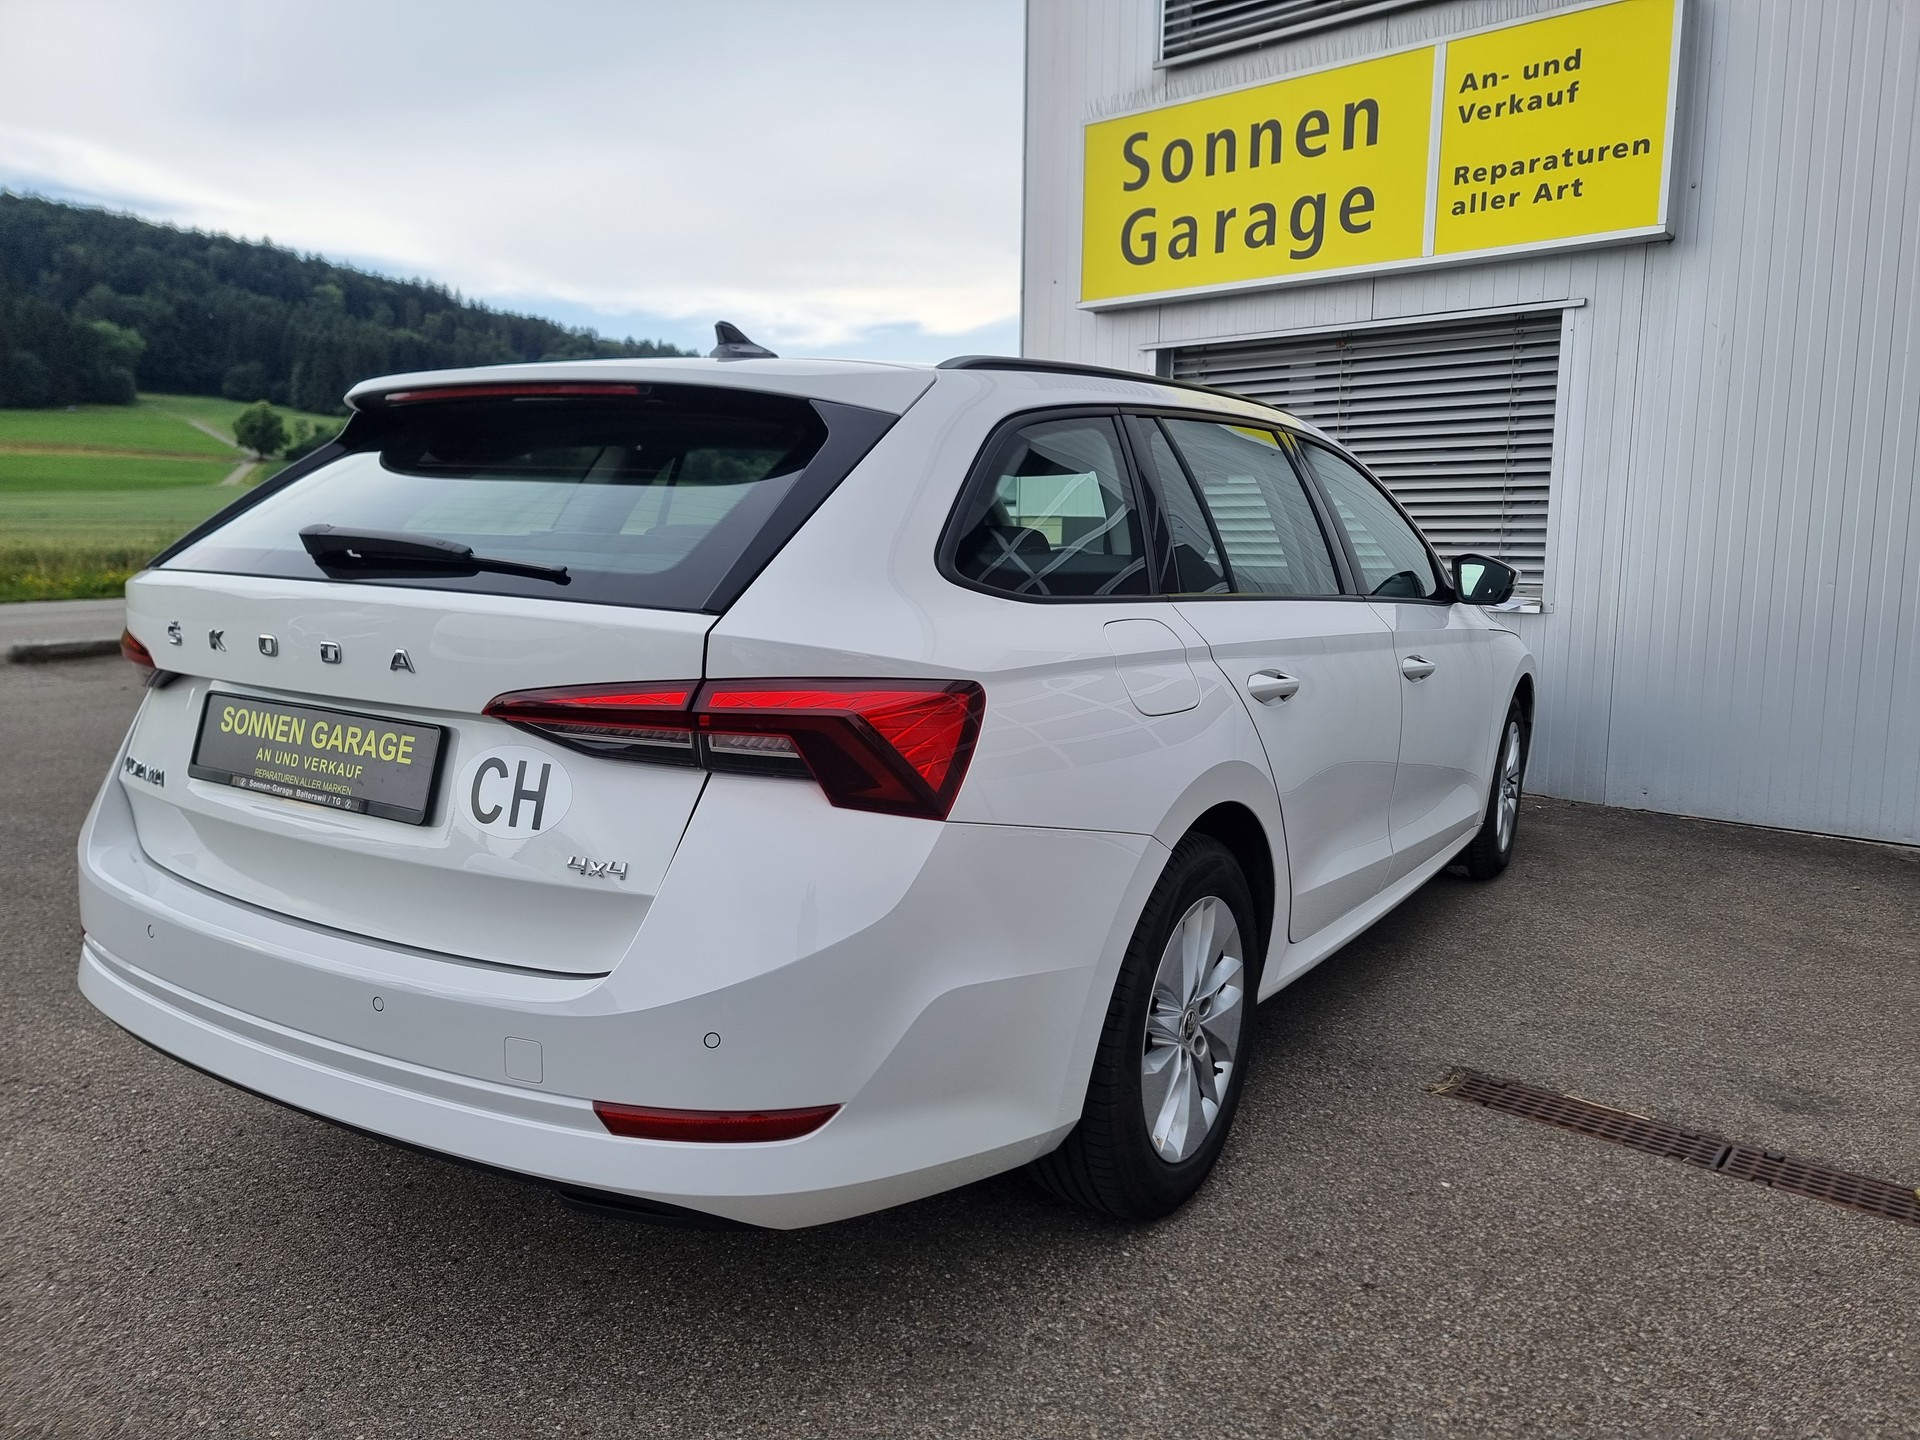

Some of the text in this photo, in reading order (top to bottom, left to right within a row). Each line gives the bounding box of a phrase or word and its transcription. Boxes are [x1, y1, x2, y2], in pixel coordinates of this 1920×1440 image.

[1458, 48, 1582, 94] An- und
[1458, 81, 1581, 125] Verkauf
[1122, 97, 1380, 192] Sonnen
[1453, 137, 1652, 186] Reparaturen
[1451, 178, 1584, 217] aller Art
[1120, 182, 1376, 266] Garage
[220, 706, 416, 765] SONNEN GARAGE
[255, 768, 352, 795] REPARATUREN ALLER MARKEN
[256, 747, 363, 780] AN UND VERKAUF
[249, 779, 293, 795] Sonnen-Garage
[332, 796, 341, 805] TG
[471, 757, 552, 830] CH
[567, 856, 628, 881] 4x4
